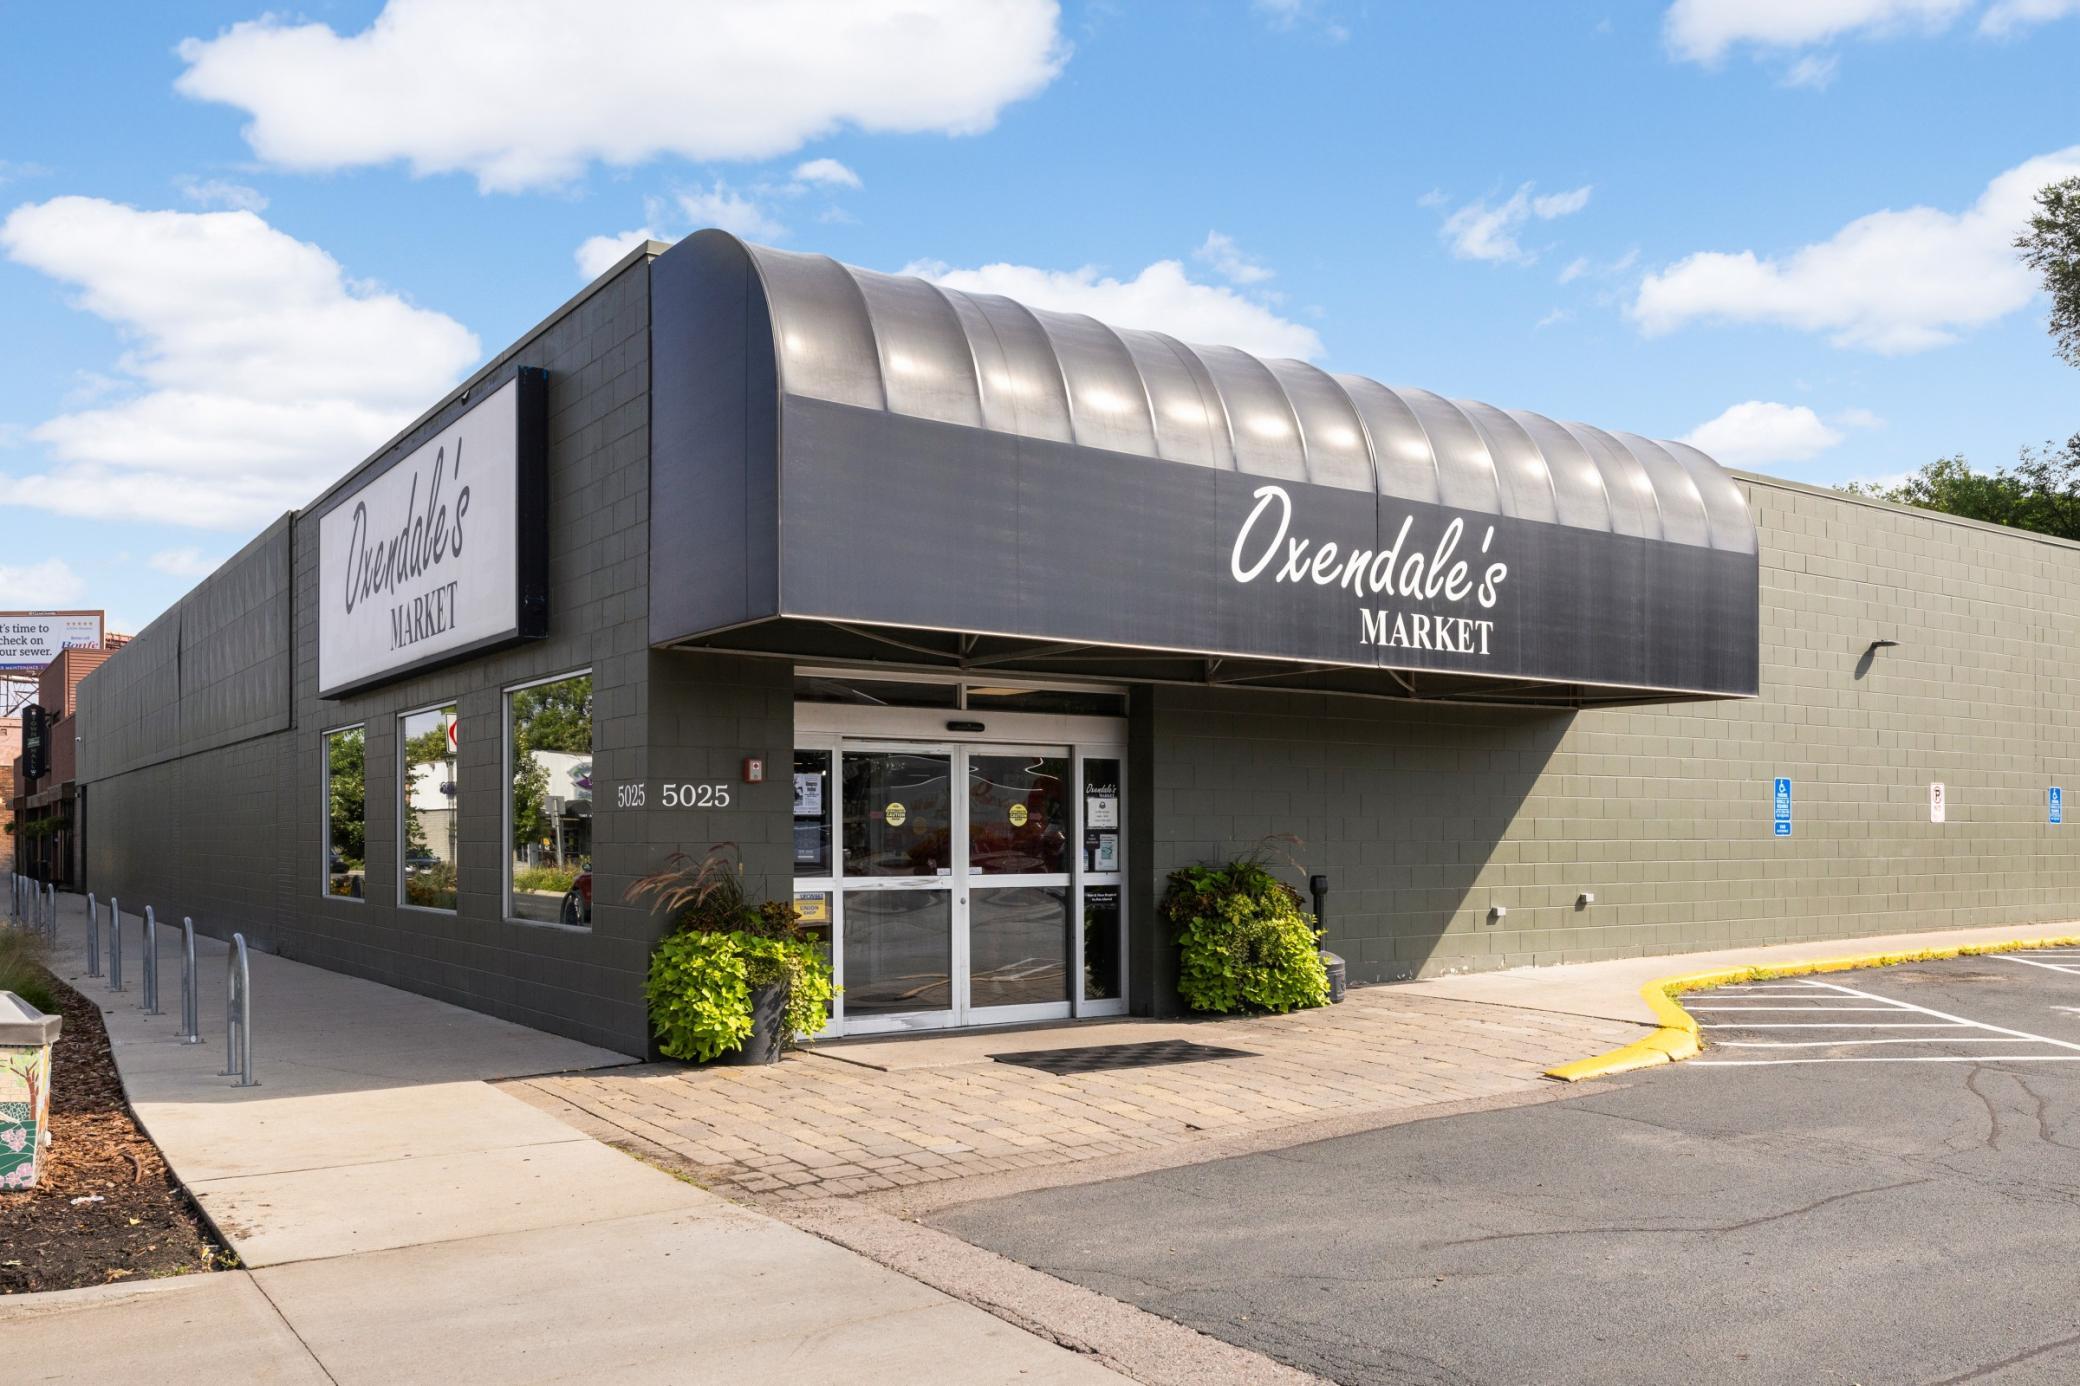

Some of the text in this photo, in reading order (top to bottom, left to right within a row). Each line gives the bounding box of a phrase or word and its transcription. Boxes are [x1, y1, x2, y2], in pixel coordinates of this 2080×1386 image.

[345, 436, 470, 615] Oxendale's
[1231, 485, 1508, 608] Oxendale's
[390, 580, 458, 651] MARKET
[12, 624, 36, 633] time
[38, 624, 50, 633] to
[30, 637, 44, 645] on
[1359, 607, 1494, 655] MARKET
[19, 648, 53, 657] sewer.
[618, 783, 646, 808] 5025
[662, 783, 730, 807] 5025
